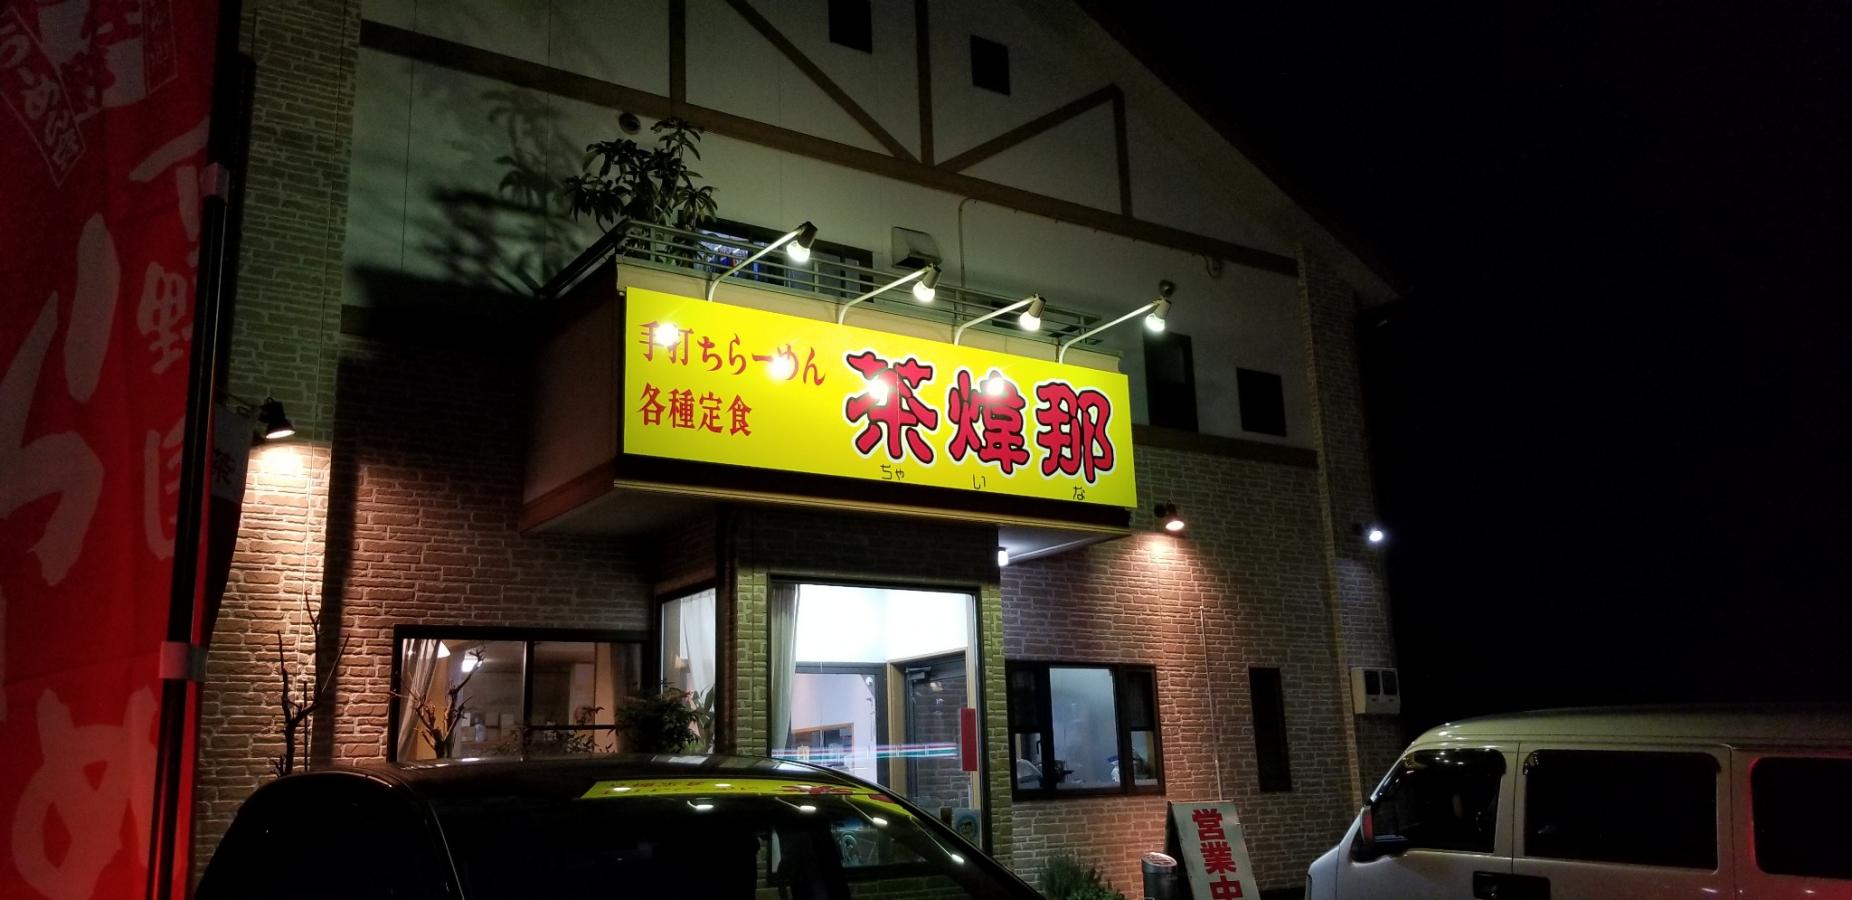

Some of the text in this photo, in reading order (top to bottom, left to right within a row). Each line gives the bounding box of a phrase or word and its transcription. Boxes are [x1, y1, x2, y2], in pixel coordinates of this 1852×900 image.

[637, 381, 753, 437] 各種定食
[880, 463, 1086, 501] ちゃ い な
[1191, 808, 1243, 900] 営業中
